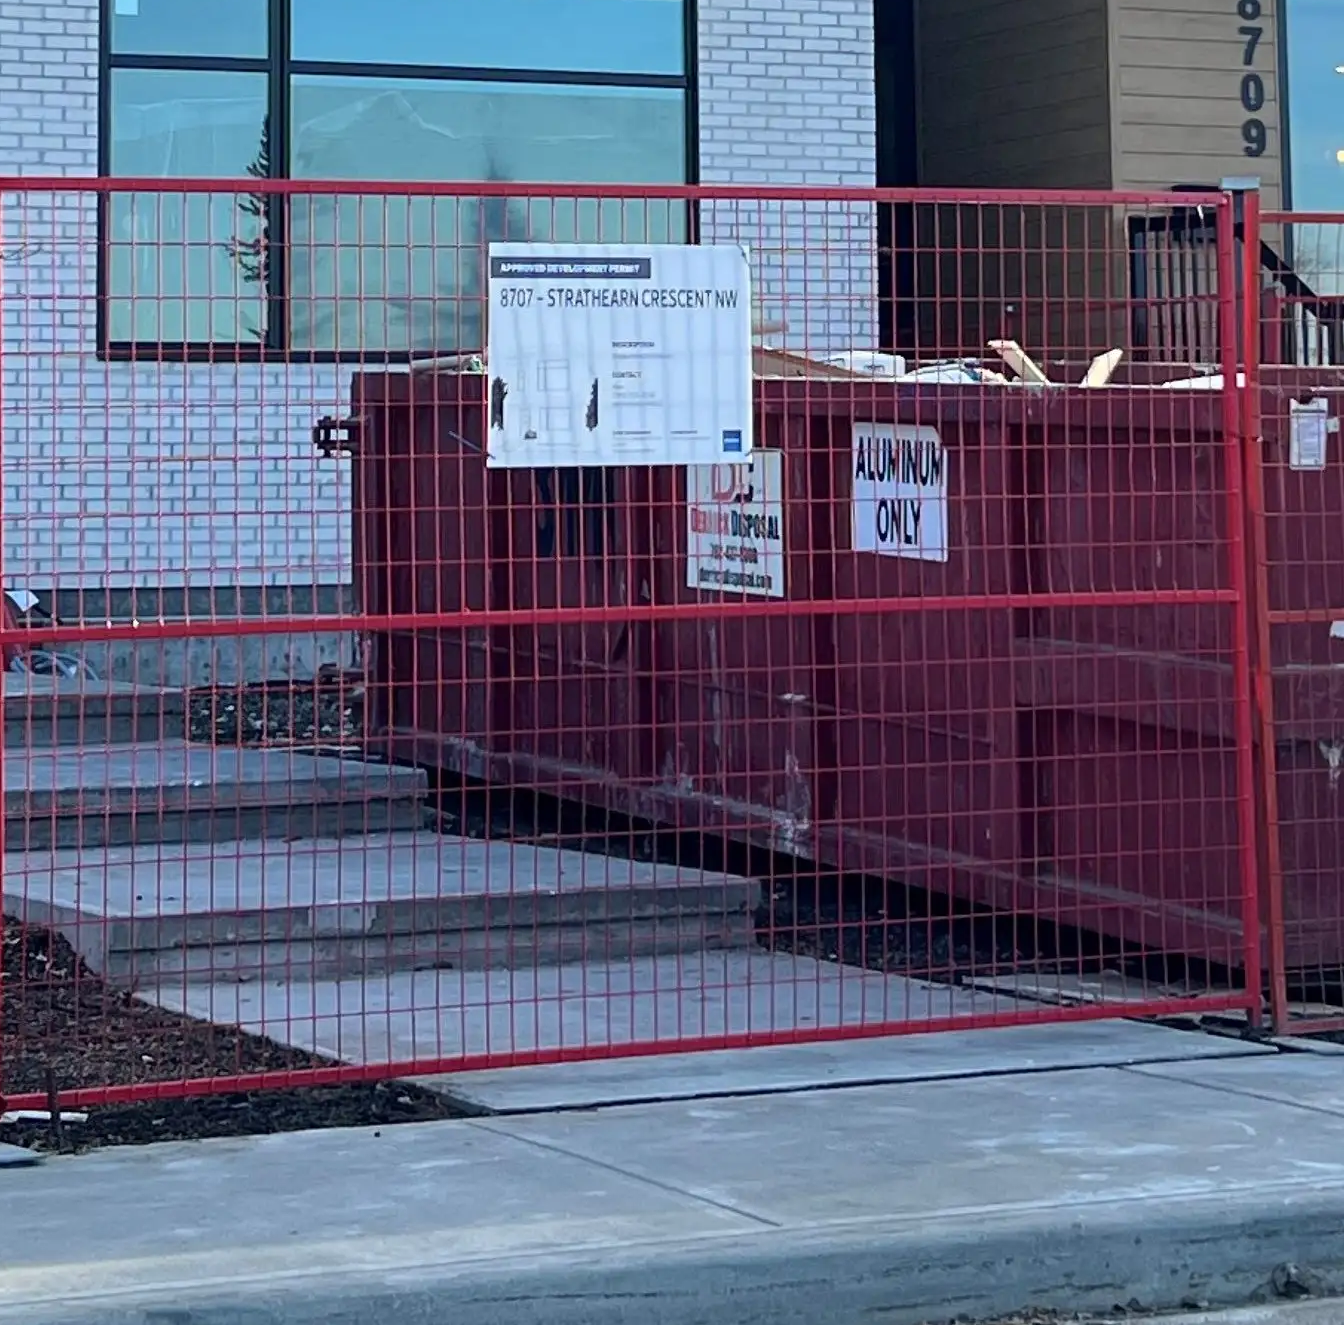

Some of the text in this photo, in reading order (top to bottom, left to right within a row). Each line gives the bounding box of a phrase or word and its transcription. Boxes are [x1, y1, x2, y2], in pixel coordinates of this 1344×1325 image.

[500, 287, 534, 308] 8707
[547, 288, 639, 308] STRATHEARN
[641, 289, 710, 309] CRESCENT
[714, 289, 738, 309] NW
[856, 436, 942, 487] ALUMINUM
[877, 497, 921, 545] ONLY
